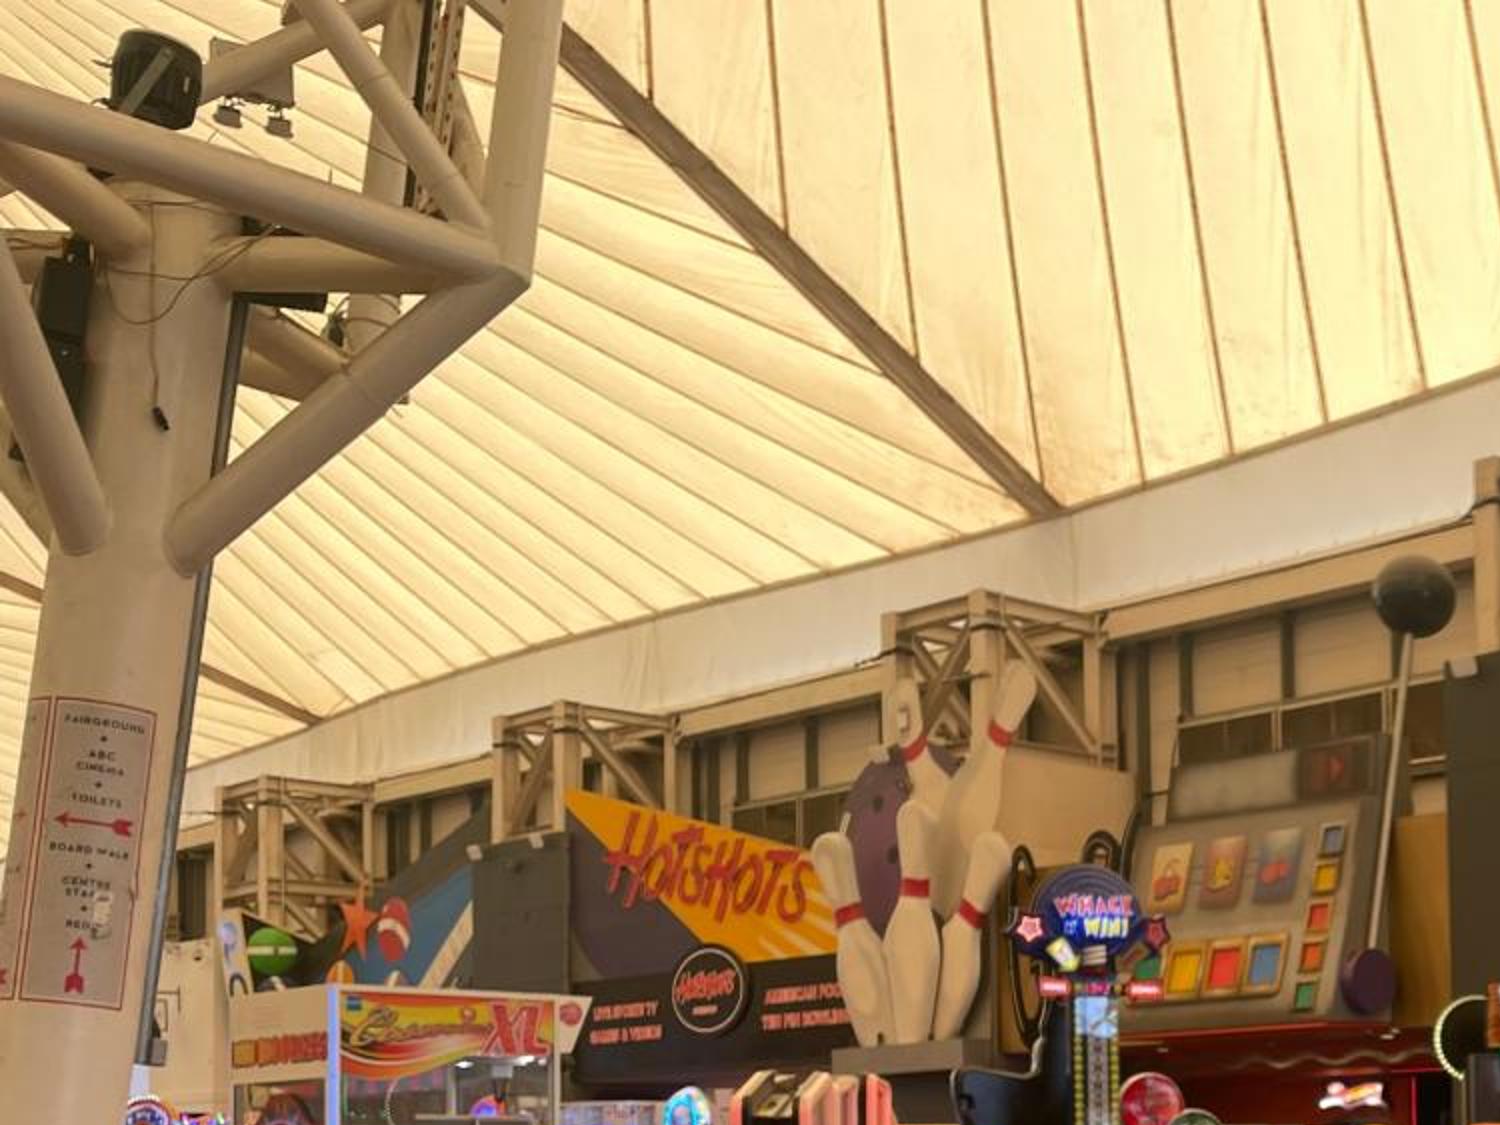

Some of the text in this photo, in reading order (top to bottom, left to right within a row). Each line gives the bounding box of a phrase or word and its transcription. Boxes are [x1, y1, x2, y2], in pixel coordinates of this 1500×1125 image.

[64, 713, 146, 735] FAIRGROUND
[88, 749, 116, 762] ABC
[75, 760, 125, 777] CINEMA
[71, 791, 123, 809] TOILETS
[48, 840, 129, 860] BOARD WALK
[604, 810, 808, 925] HOTSHOTS
[61, 874, 112, 892] CENTRE
[1054, 891, 1134, 918] WHACK
[482, 1002, 551, 1057] XL
